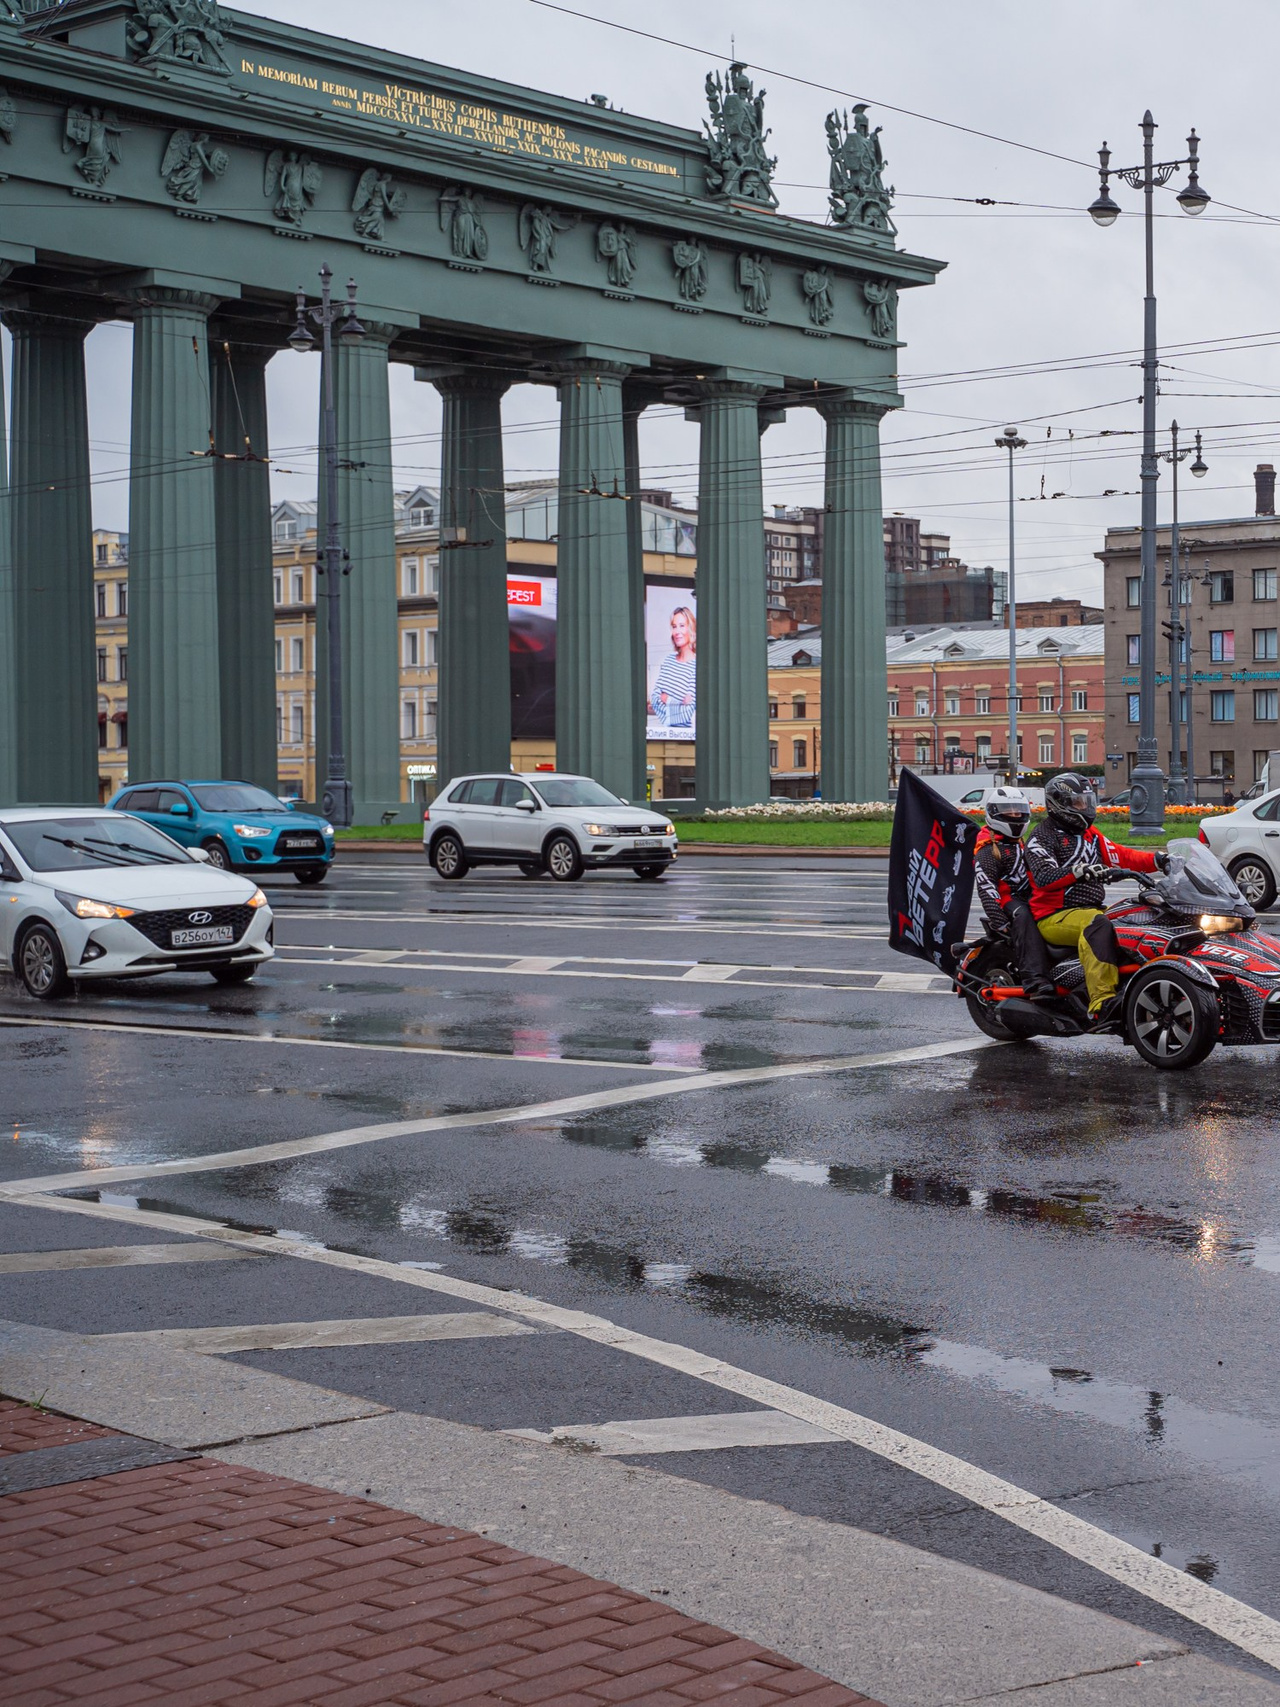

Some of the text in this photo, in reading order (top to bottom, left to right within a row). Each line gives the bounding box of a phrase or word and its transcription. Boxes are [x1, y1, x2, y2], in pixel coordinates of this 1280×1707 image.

[241, 59, 254, 74] IN
[258, 65, 318, 90] MEMORIAM
[322, 81, 358, 100] RERUM
[362, 91, 397, 110] PERSIS
[401, 101, 414, 114] ET
[418, 104, 453, 123] TURCIS
[457, 115, 519, 139] DEBELLANDIS
[524, 132, 536, 143] AC
[541, 135, 580, 154] POLONIS
[584, 146, 627, 165] PACANDIS
[385, 84, 566, 140] VICTRICIBUS COPIIS RUTHENICIS
[407, 764, 437, 775] ОПТИКА
